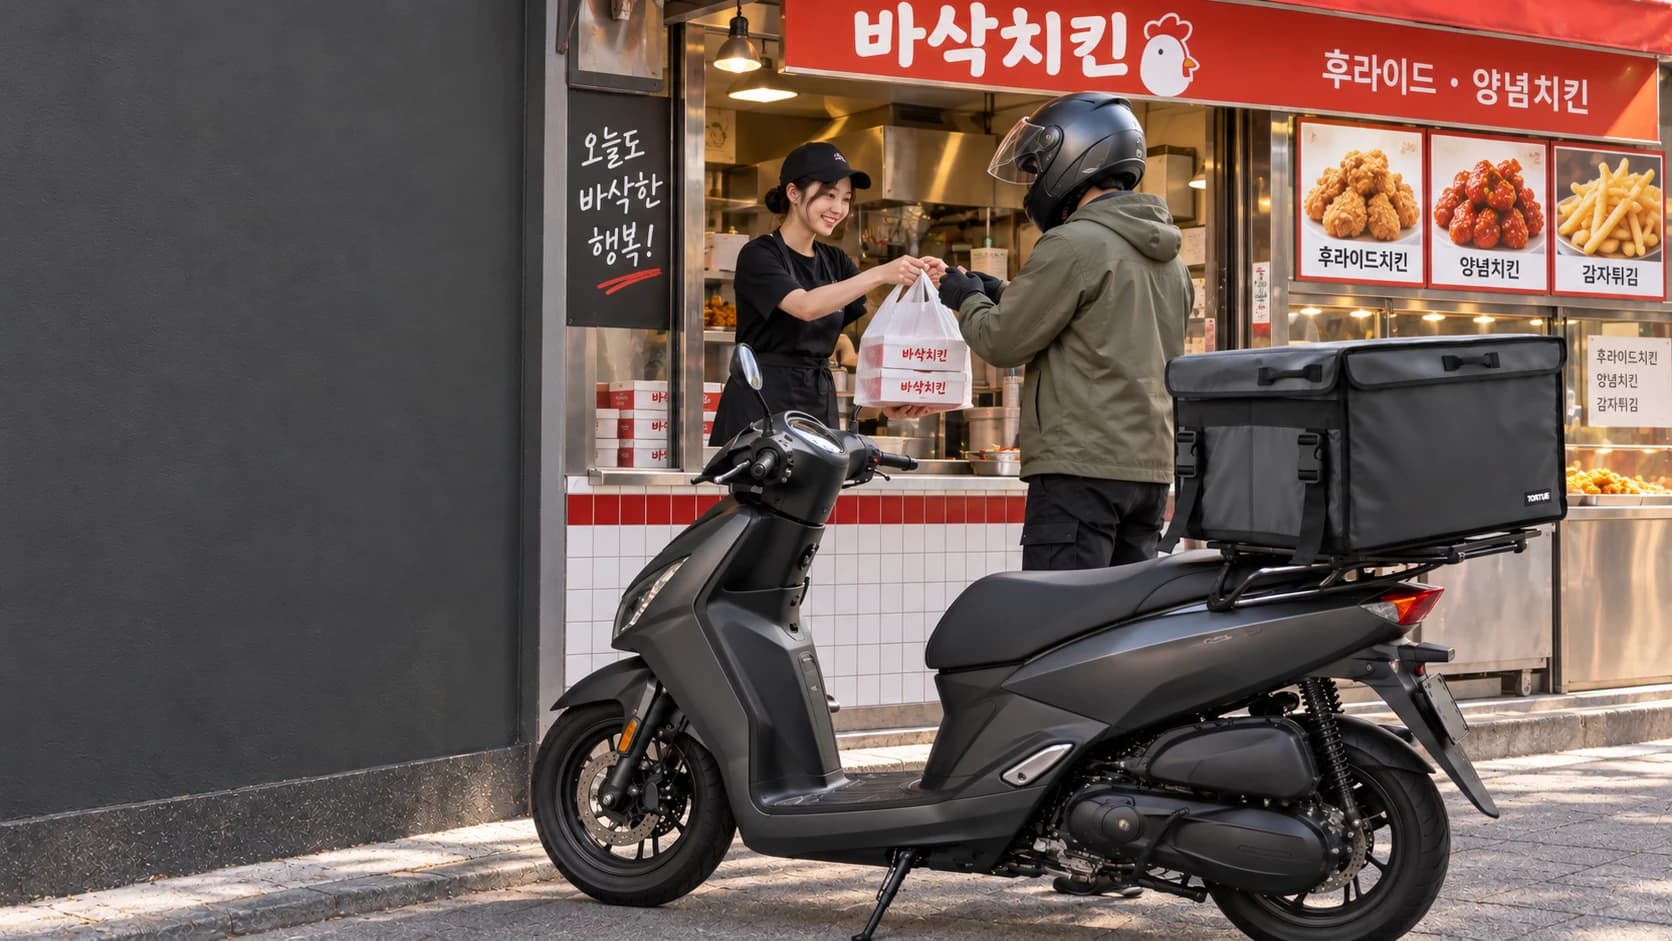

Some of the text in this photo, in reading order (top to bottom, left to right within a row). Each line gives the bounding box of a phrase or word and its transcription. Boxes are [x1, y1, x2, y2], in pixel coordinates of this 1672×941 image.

[854, 2, 1128, 78] 바삭치킨
[1322, 48, 1437, 96] 후라이드
[1472, 68, 1589, 115] 양념치킨
[581, 126, 646, 169] 오늘도
[579, 171, 663, 215] 바삭한
[587, 221, 654, 267] 행복!
[1318, 246, 1408, 273] 후라이드치킨
[1459, 256, 1520, 280] 양념치킨
[1582, 264, 1639, 287] 감자튀김
[902, 347, 948, 363] 바삭치킨
[1596, 348, 1658, 366] 후라이드치킨
[900, 381, 946, 395] 바삭치킨
[1596, 372, 1638, 389] 양념치킨
[1596, 396, 1638, 413] 감자튀김
